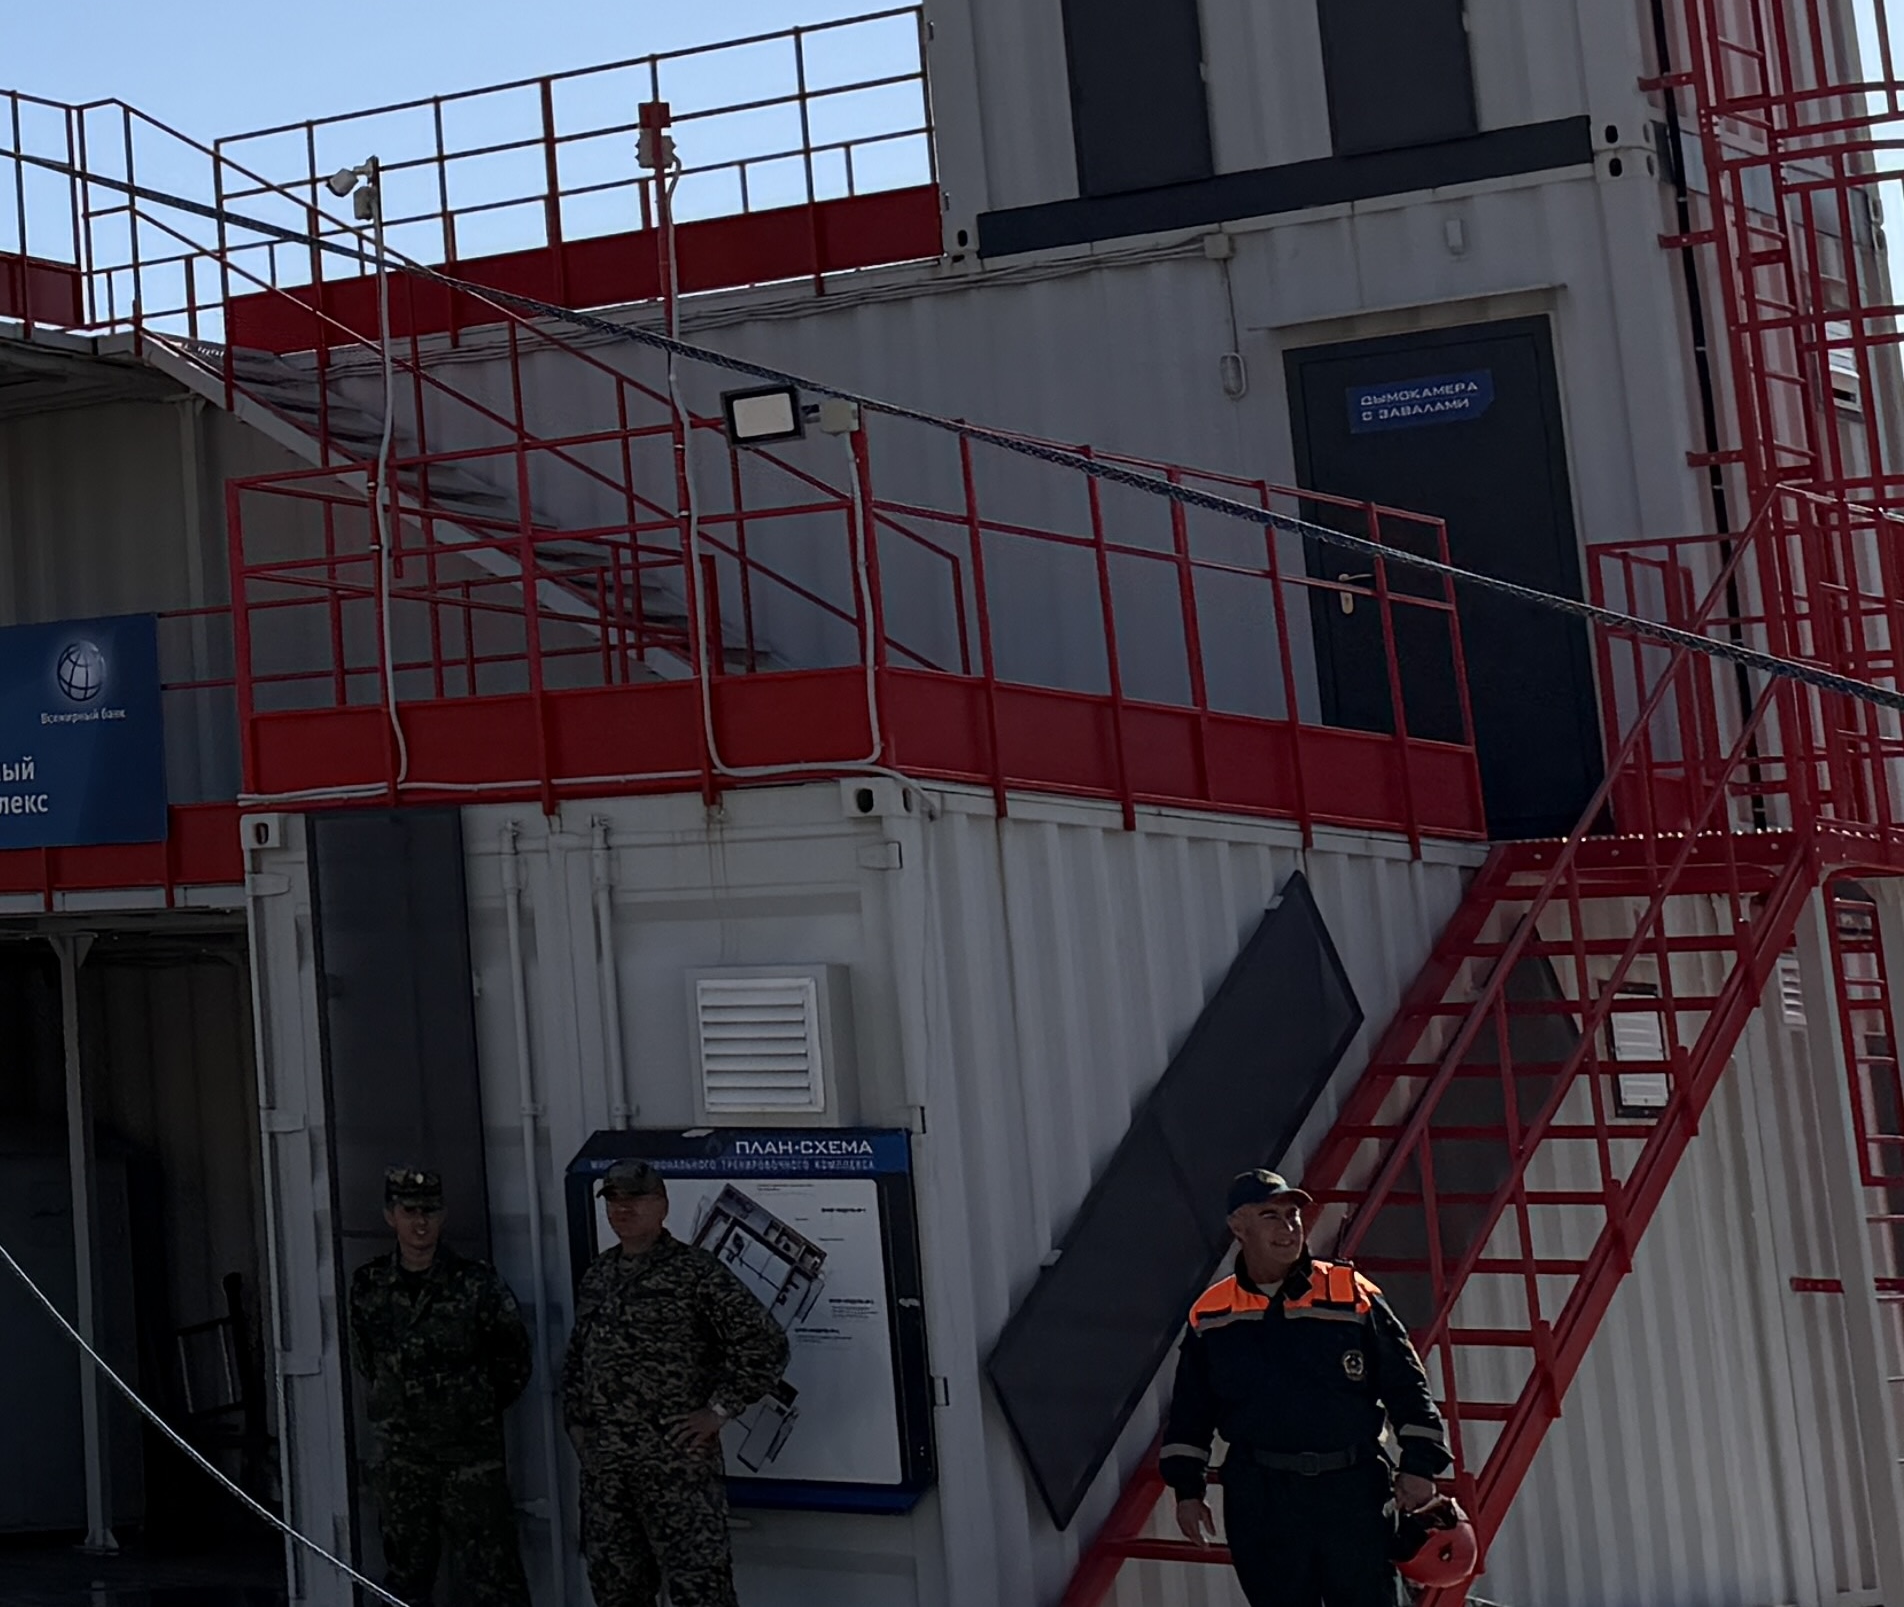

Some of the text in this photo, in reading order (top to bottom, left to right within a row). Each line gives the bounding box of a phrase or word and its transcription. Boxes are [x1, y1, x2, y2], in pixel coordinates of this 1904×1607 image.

[1360, 381, 1478, 406] ДЫМОКАМЕРА
[1361, 398, 1470, 421] С ЗАВАЛАМИ
[41, 707, 125, 724] Всемирный банк
[735, 1140, 874, 1156] ПЛАН-СХЕМА
[814, 1159, 875, 1171] КОМПЛЕКСА
